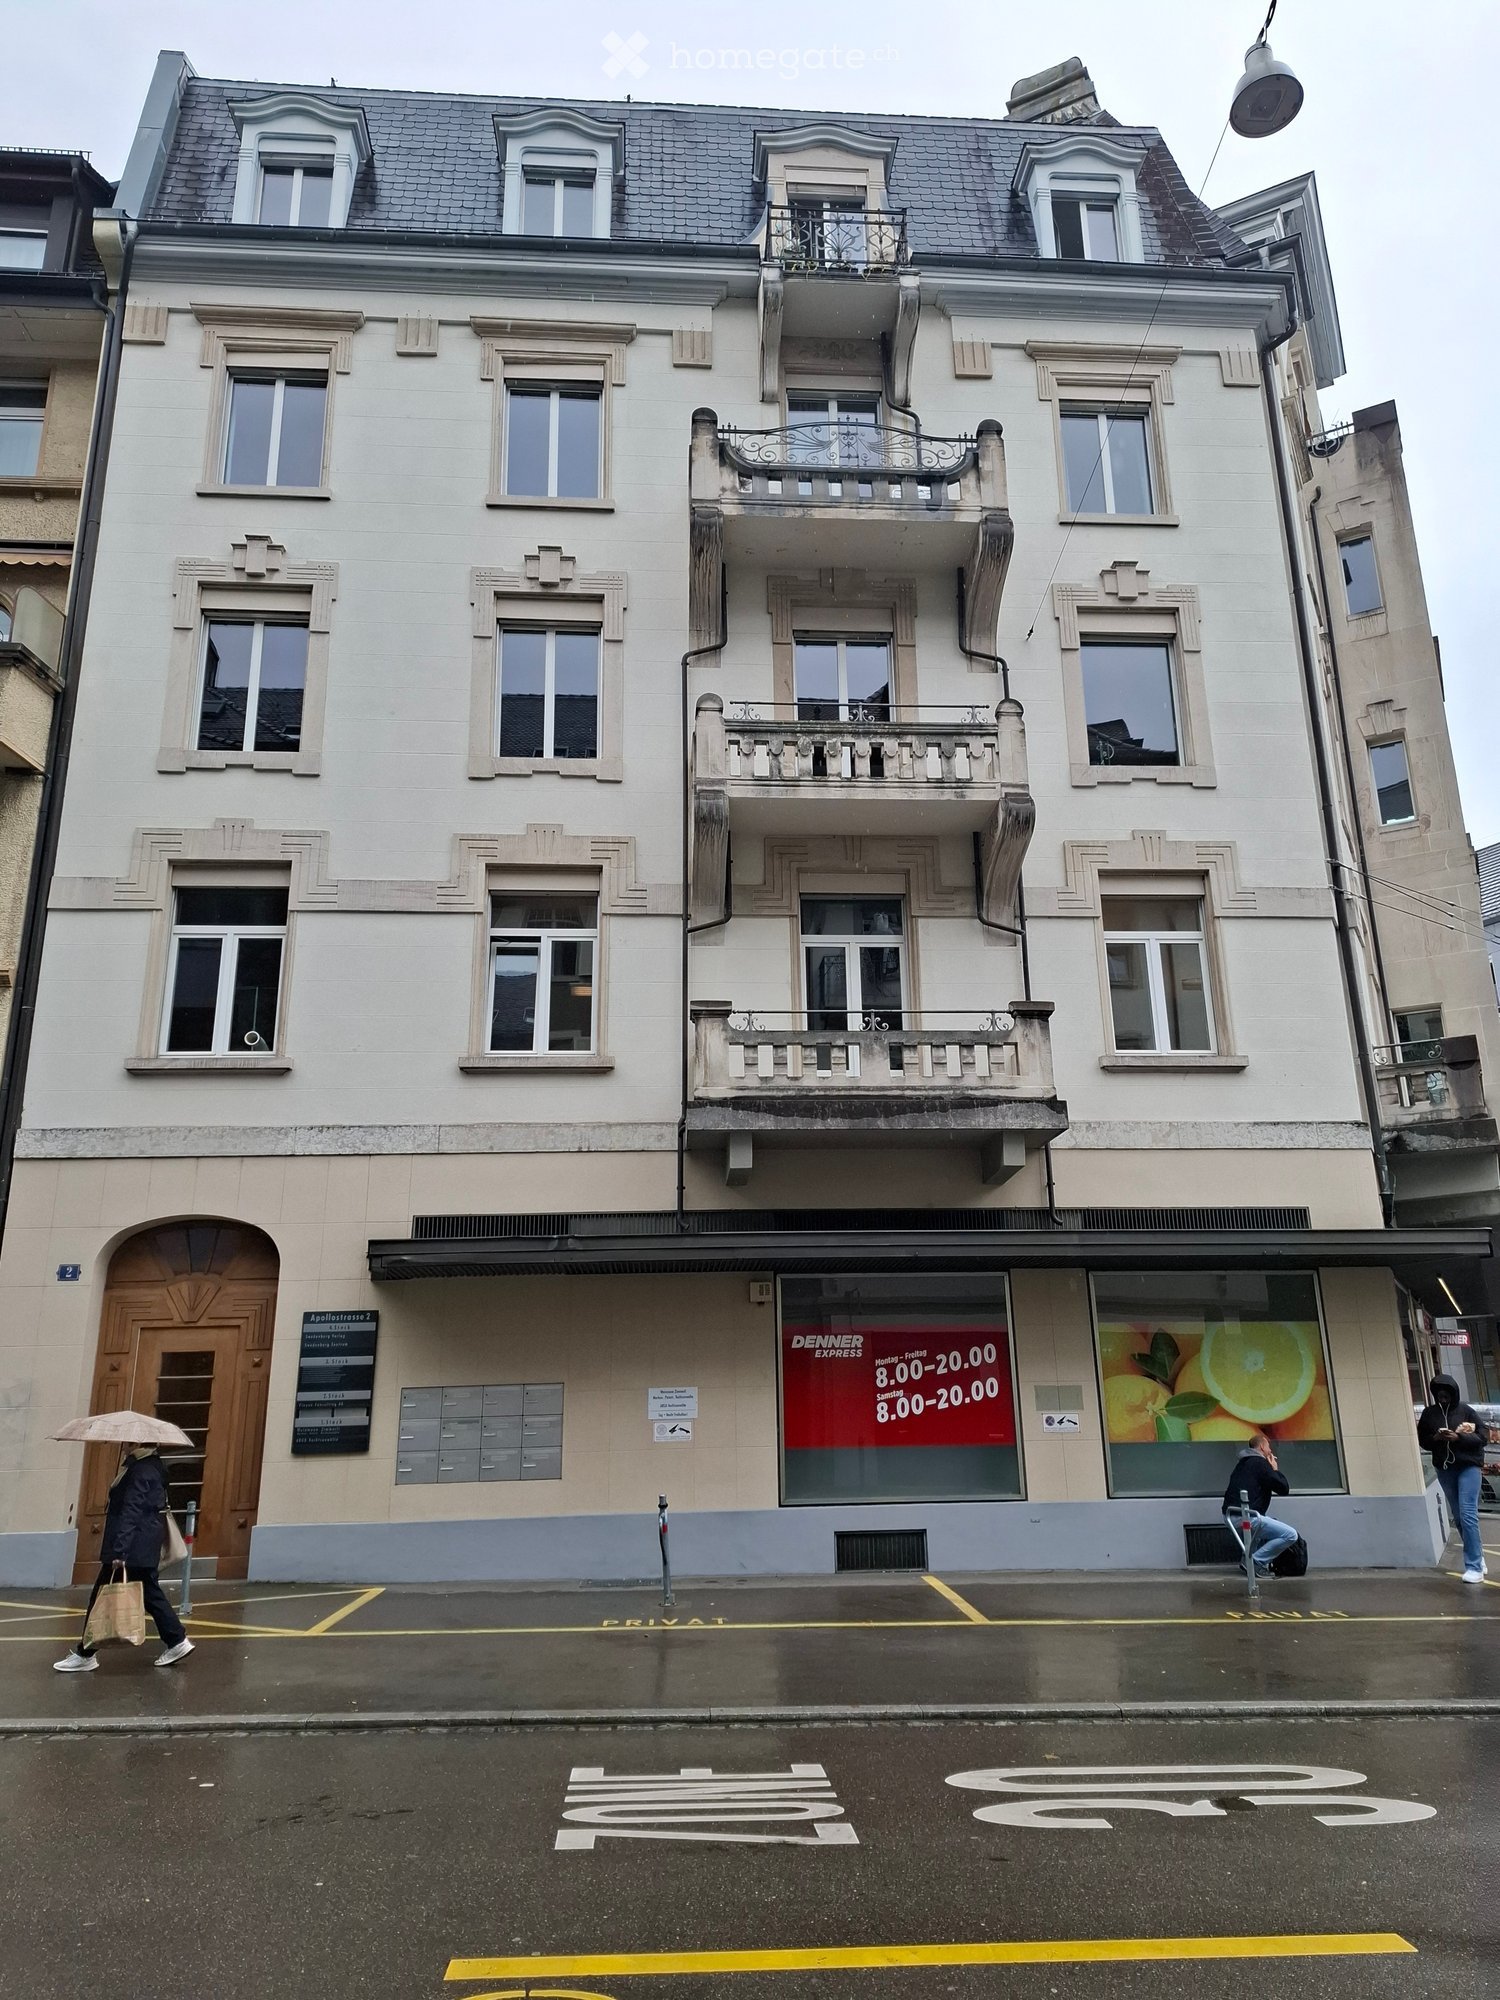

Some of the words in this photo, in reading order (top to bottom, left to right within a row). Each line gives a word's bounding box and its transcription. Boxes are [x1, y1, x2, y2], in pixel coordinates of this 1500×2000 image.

[65, 1266, 73, 1278] 2
[310, 1313, 365, 1323] Apollostrasse
[366, 1312, 371, 1320] 2
[791, 1335, 864, 1349] DENNER
[814, 1348, 863, 1358] EXPRESS
[875, 1355, 899, 1367] Montag
[904, 1349, 927, 1360] Freitag
[876, 1389, 904, 1401] Samstag
[1225, 1610, 1350, 1619] PRIVAT
[602, 1617, 729, 1627] PRIVAT
